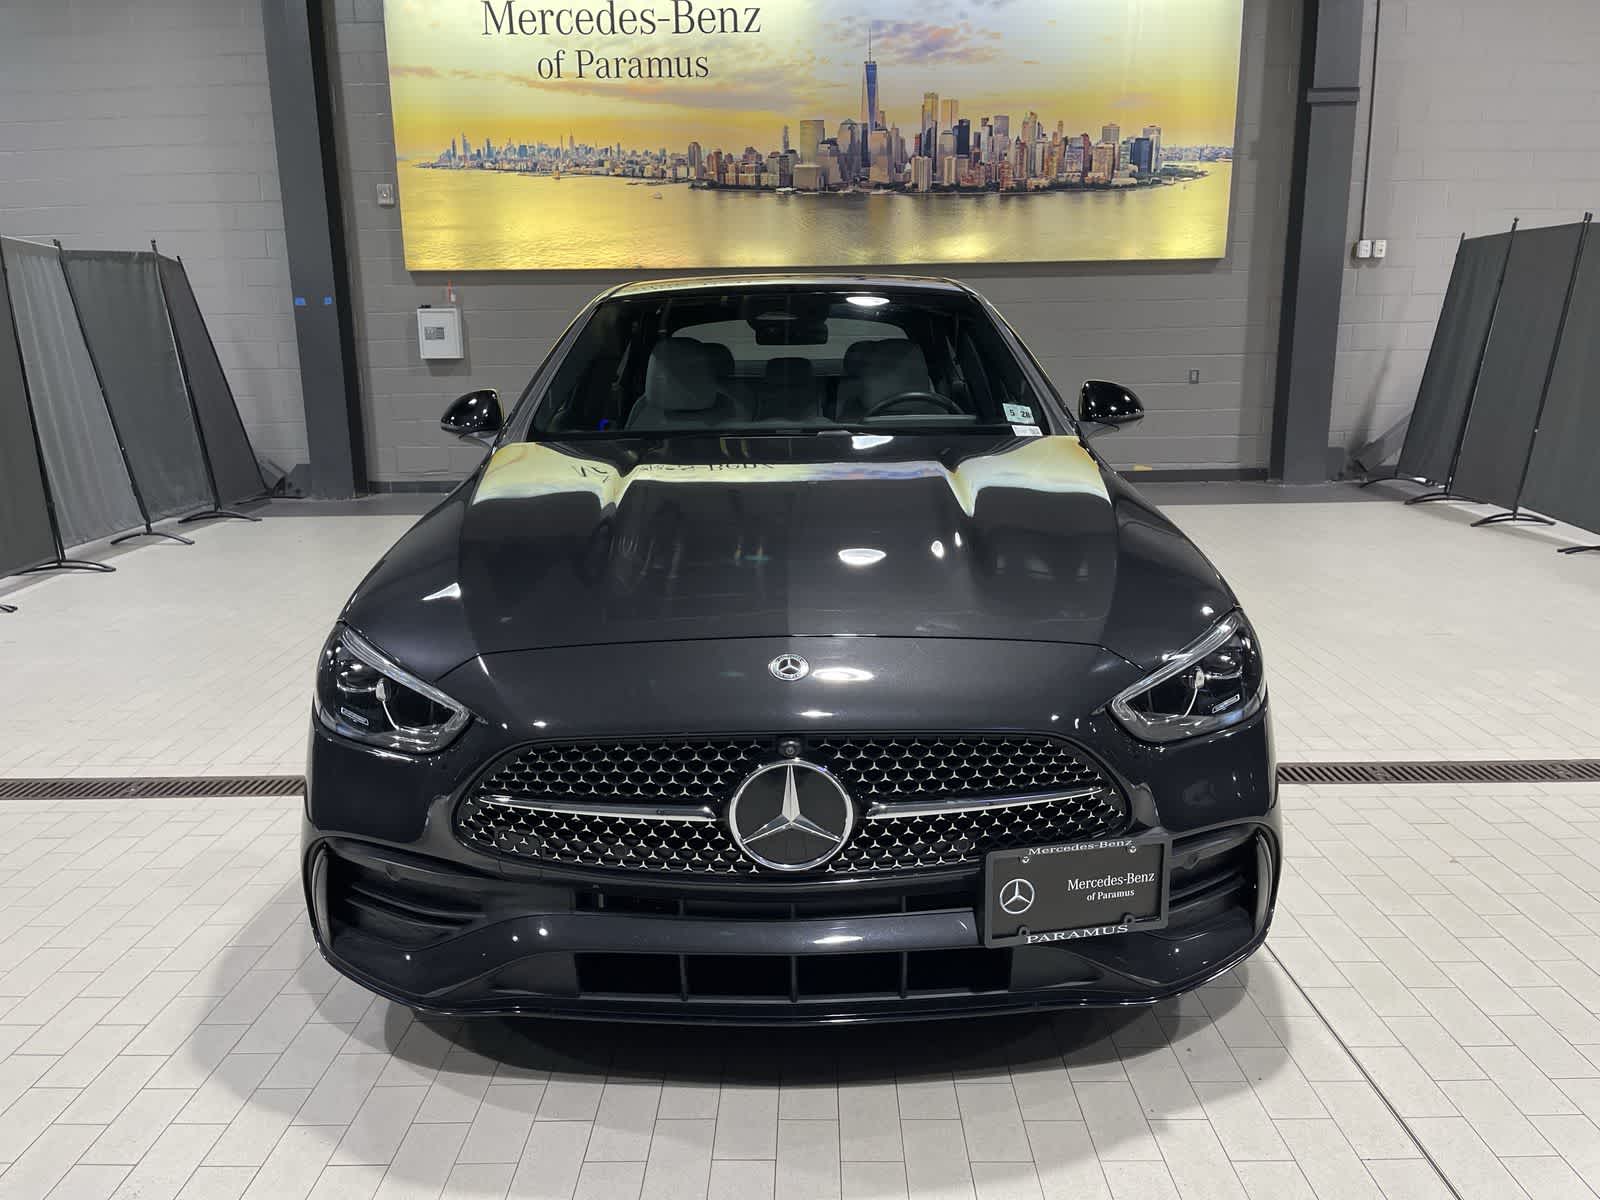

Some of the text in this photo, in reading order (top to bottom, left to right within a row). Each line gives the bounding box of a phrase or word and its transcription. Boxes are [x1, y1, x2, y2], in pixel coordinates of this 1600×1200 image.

[481, 0, 761, 35] Mercedes-Benz
[537, 48, 710, 80] of Paramus
[1028, 840, 1134, 855] Mercedes-Benz
[1067, 872, 1155, 892] Mercedes-Benz
[1086, 888, 1135, 902] of Paramus
[1026, 924, 1129, 944] PARAMUS
